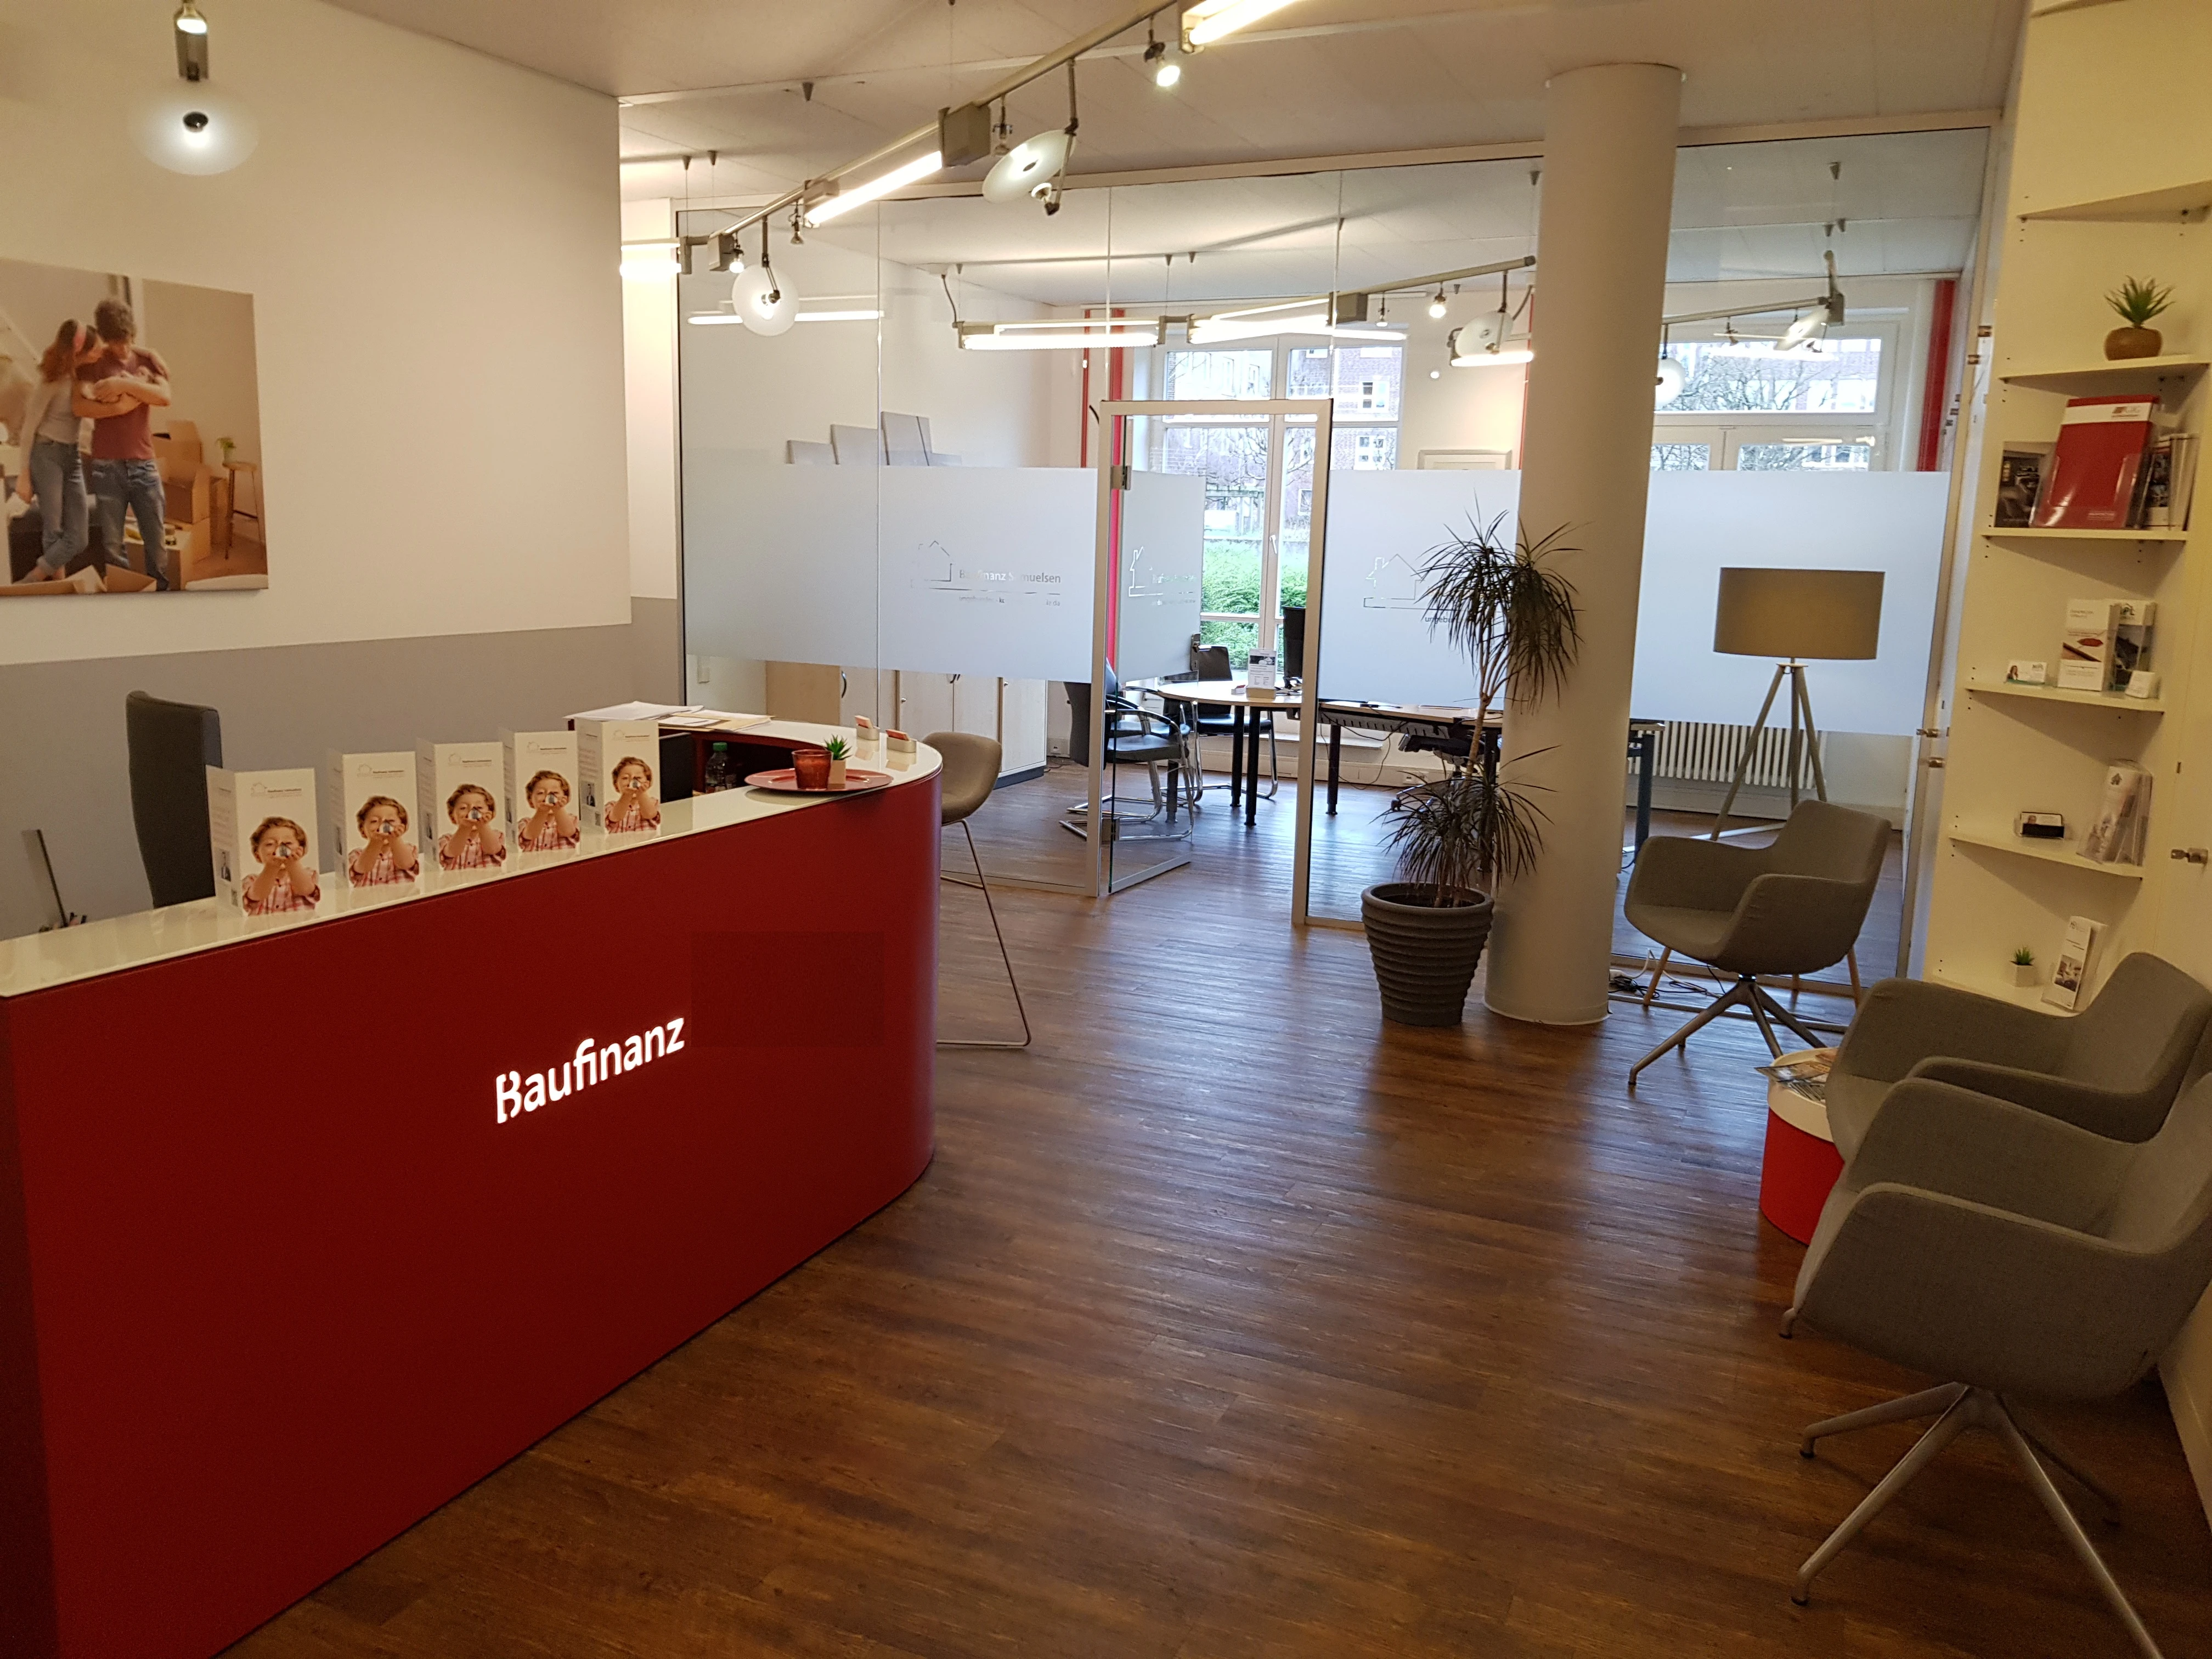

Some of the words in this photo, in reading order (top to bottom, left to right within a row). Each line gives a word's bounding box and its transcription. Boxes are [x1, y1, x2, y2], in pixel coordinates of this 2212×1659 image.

[959, 569, 1006, 581] Bfinanz
[1008, 572, 1061, 583] Smuelsen
[495, 1017, 685, 1124] Baufinanz
